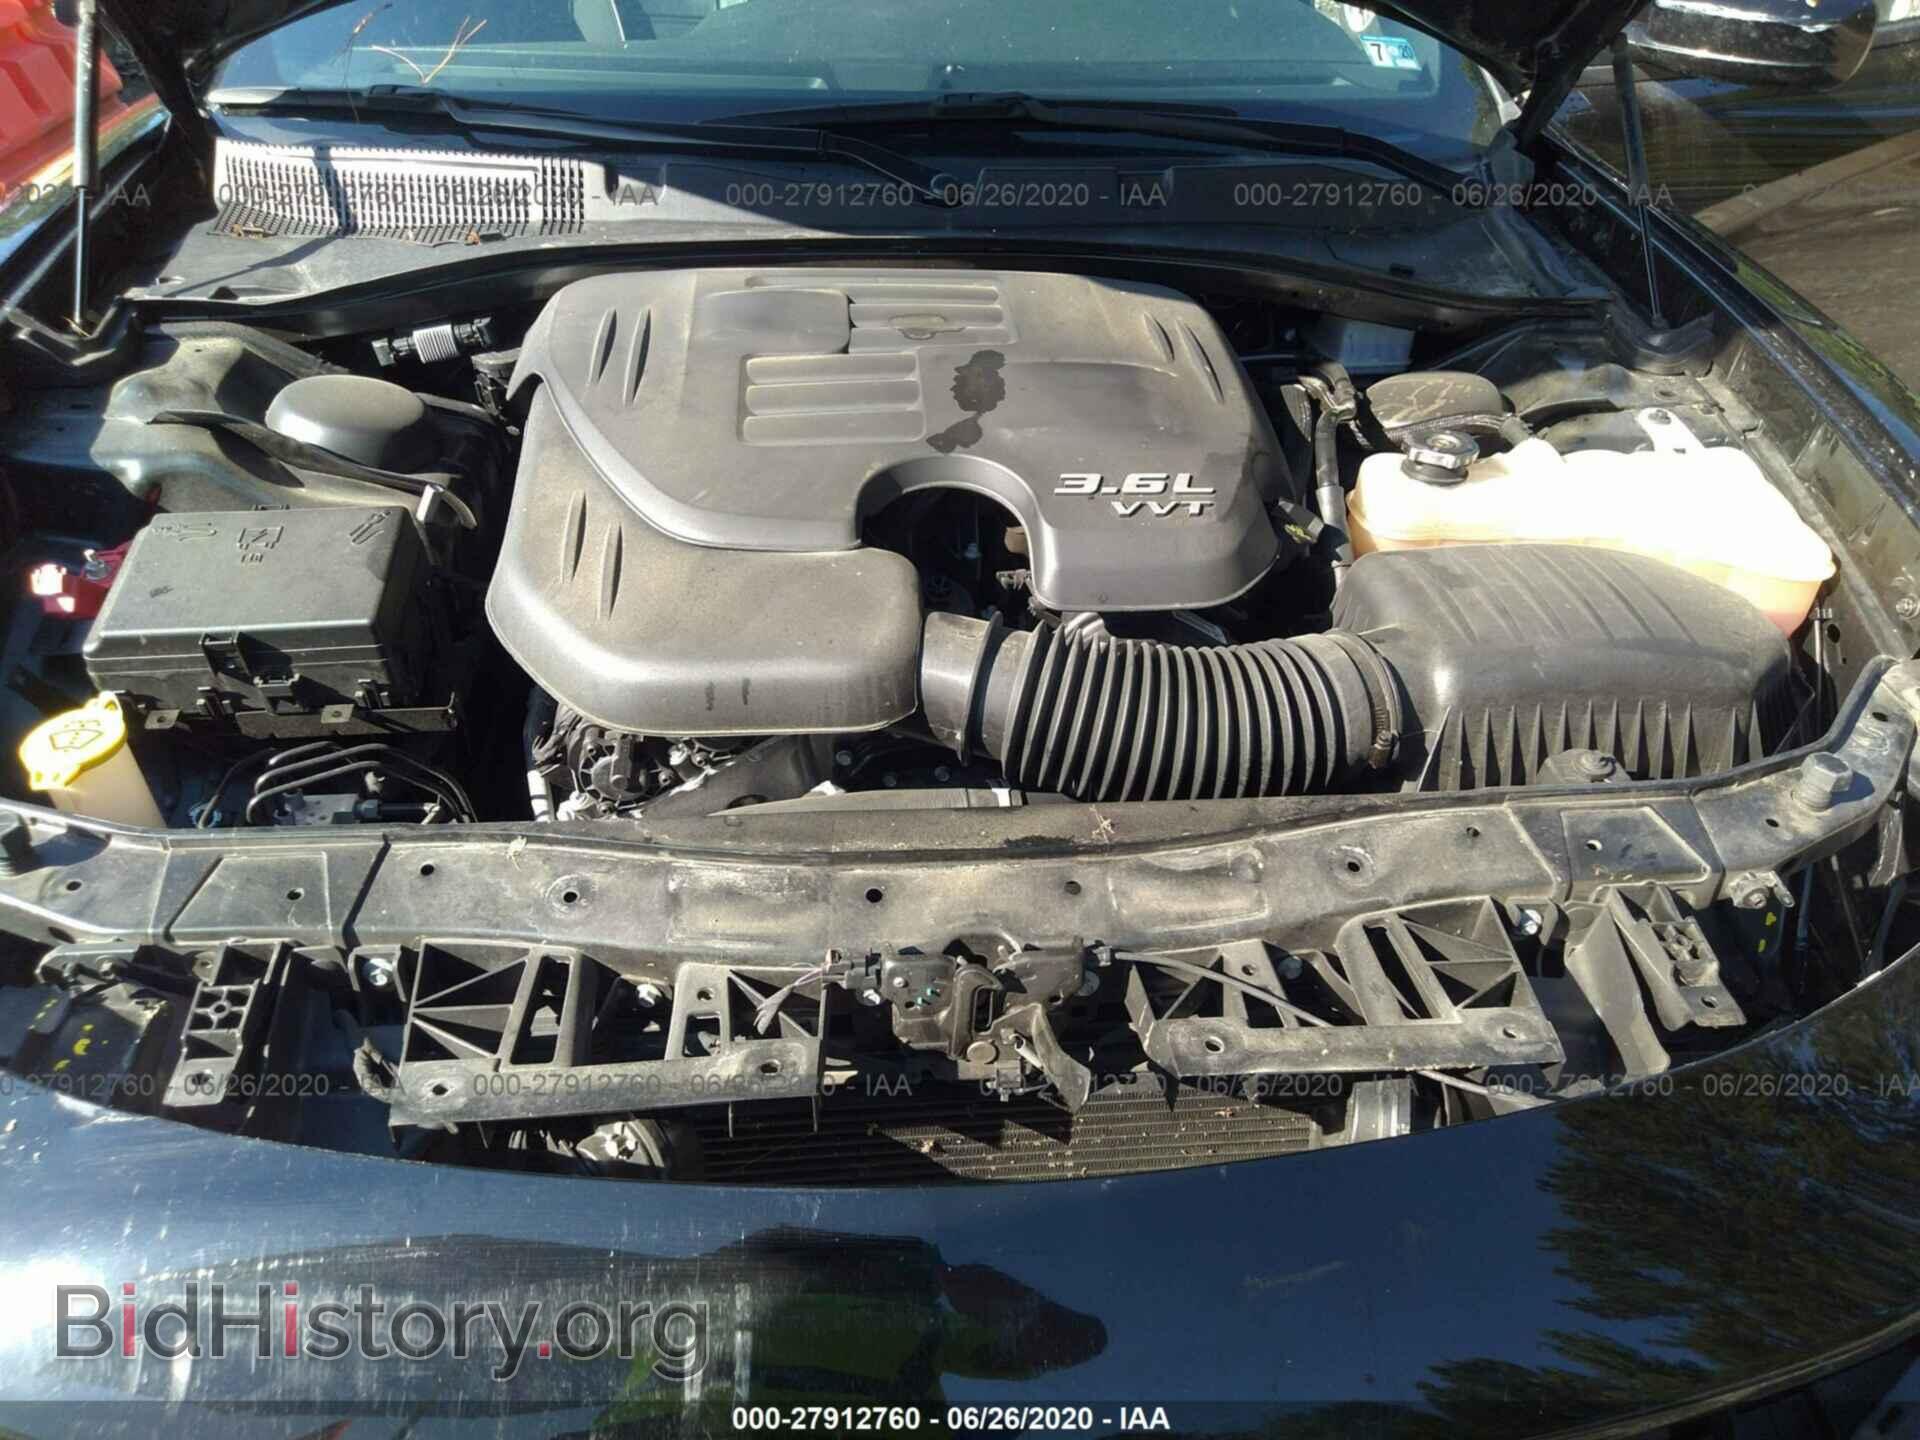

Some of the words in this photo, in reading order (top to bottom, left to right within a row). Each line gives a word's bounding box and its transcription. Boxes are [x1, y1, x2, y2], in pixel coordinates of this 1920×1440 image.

[1370, 43, 1383, 61] 7
[1054, 473, 1216, 496] 3.6L
[1110, 500, 1215, 518] VVT
